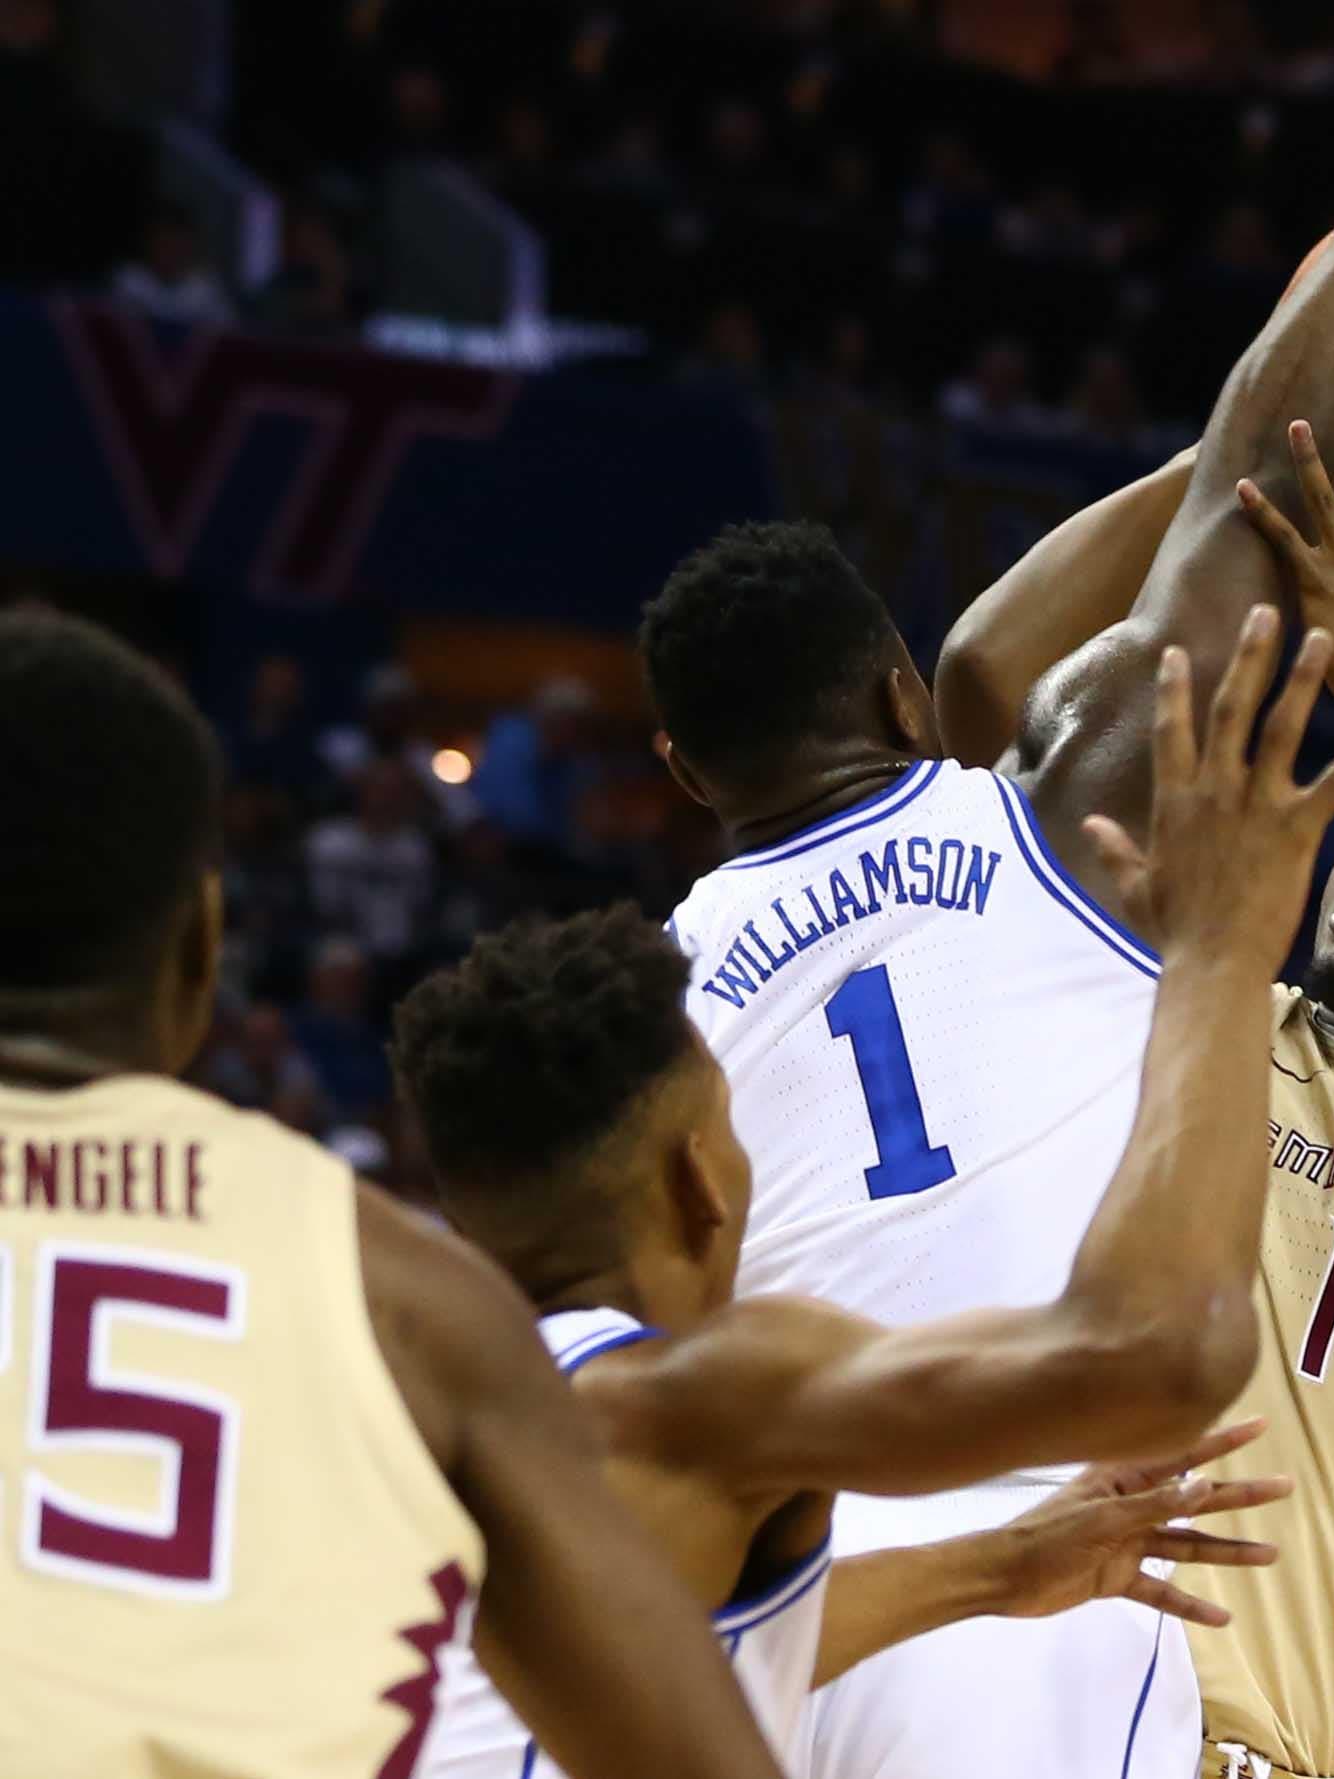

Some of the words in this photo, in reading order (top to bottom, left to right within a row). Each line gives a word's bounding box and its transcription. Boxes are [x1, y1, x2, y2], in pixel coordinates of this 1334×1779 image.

[46, 288, 524, 608] VT
[702, 837, 1002, 1011] WILLIAMSON
[0, 1138, 208, 1223] NGELE
[824, 963, 957, 1201] 1
[0, 1236, 248, 1601] 5
